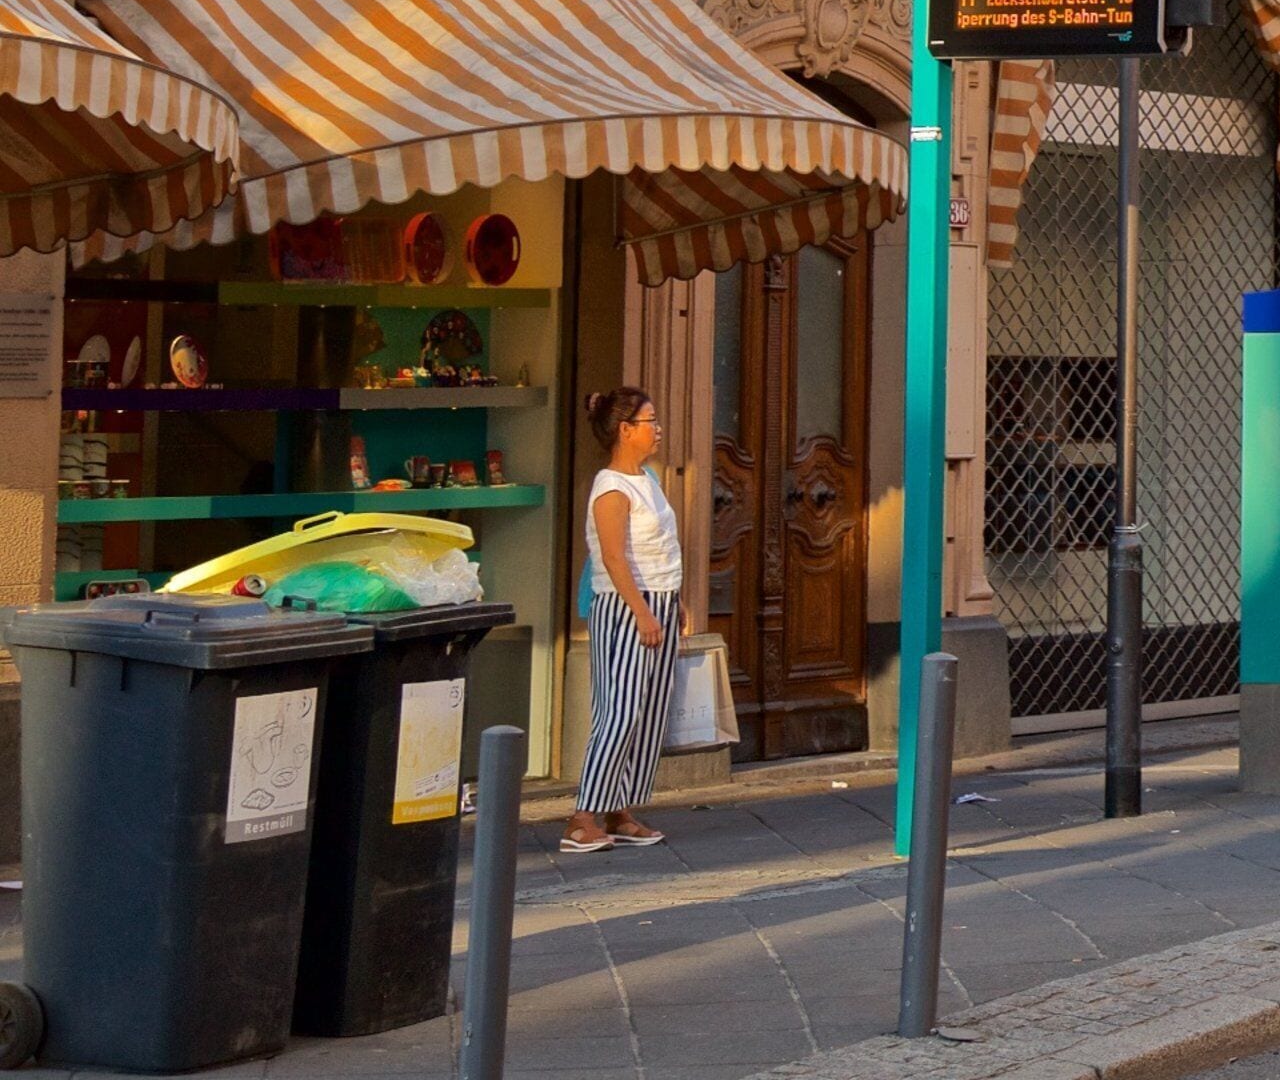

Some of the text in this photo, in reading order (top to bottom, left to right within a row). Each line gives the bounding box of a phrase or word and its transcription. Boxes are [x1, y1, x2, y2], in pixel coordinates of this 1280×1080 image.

[1021, 10, 1046, 25] des
[1049, 8, 1133, 24] S-Bahn-Tun
[951, 201, 968, 223] 36
[677, 706, 707, 720] RIT
[244, 815, 293, 835] Restmüll
